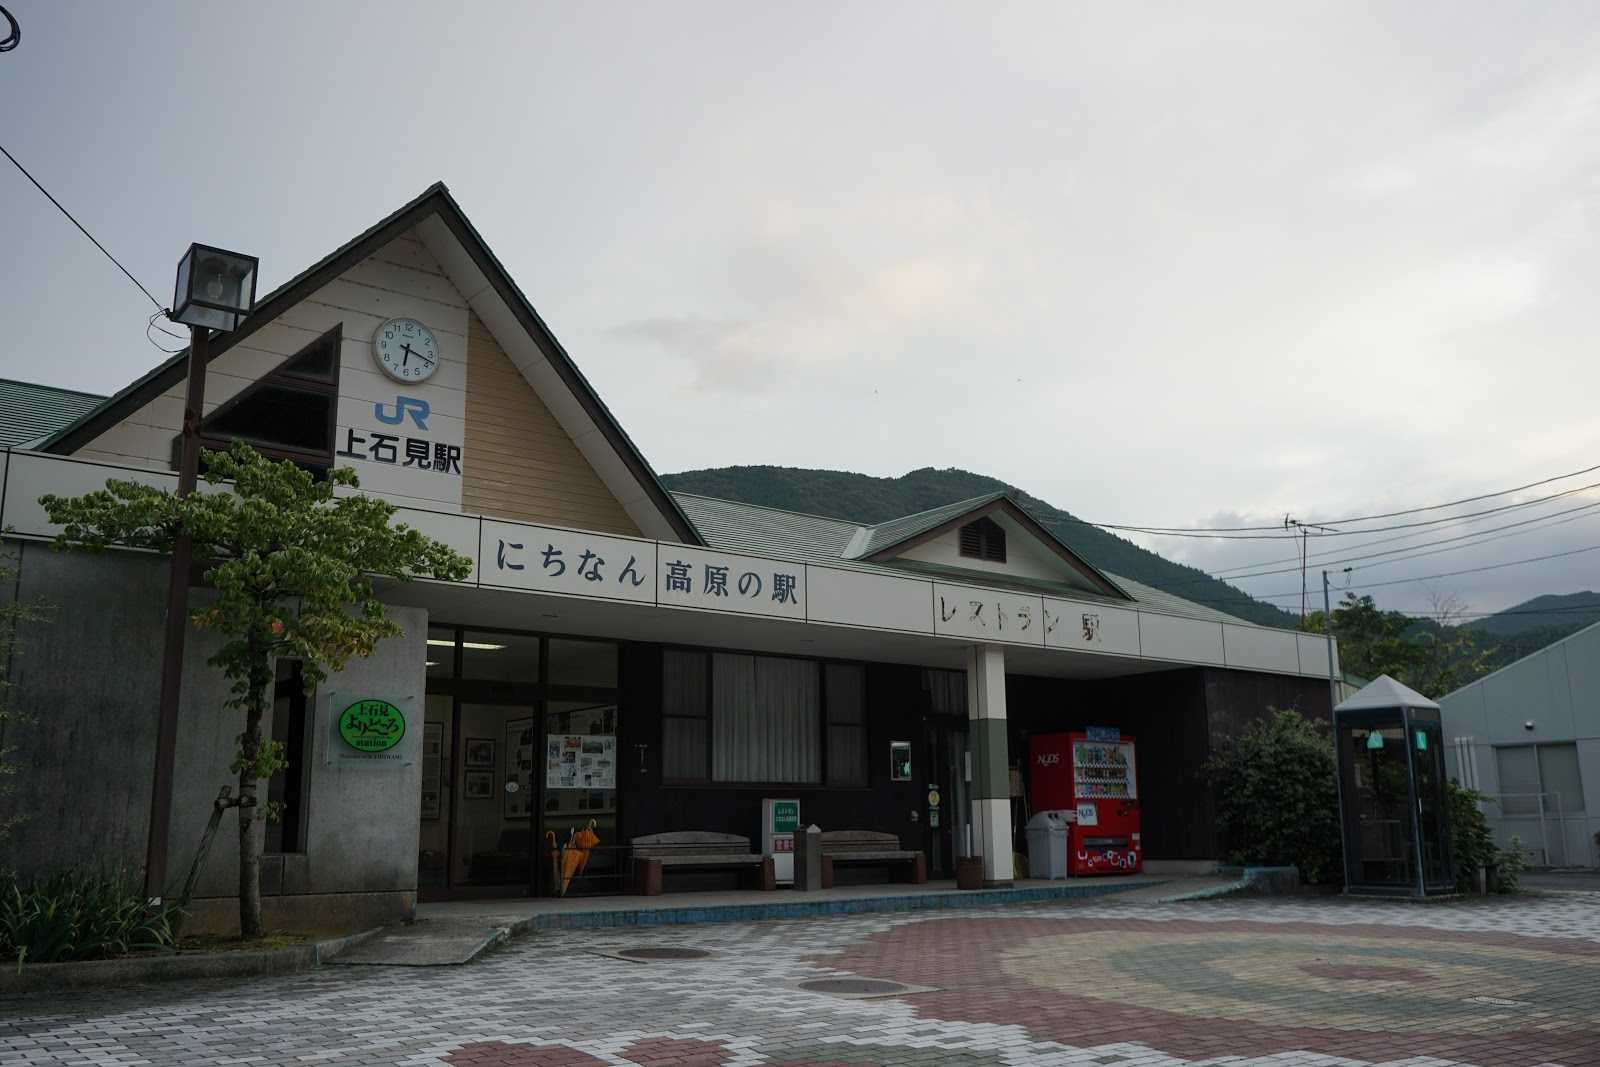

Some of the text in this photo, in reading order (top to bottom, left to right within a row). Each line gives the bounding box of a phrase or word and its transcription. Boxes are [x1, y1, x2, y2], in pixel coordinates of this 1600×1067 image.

[394, 324, 400, 332] 11
[385, 331, 393, 339] 10
[424, 338, 431, 346] 2
[384, 353, 390, 361] 8
[374, 396, 430, 431] JR
[336, 428, 462, 475] 上石見駅
[497, 540, 797, 604] にちなん高原の駅
